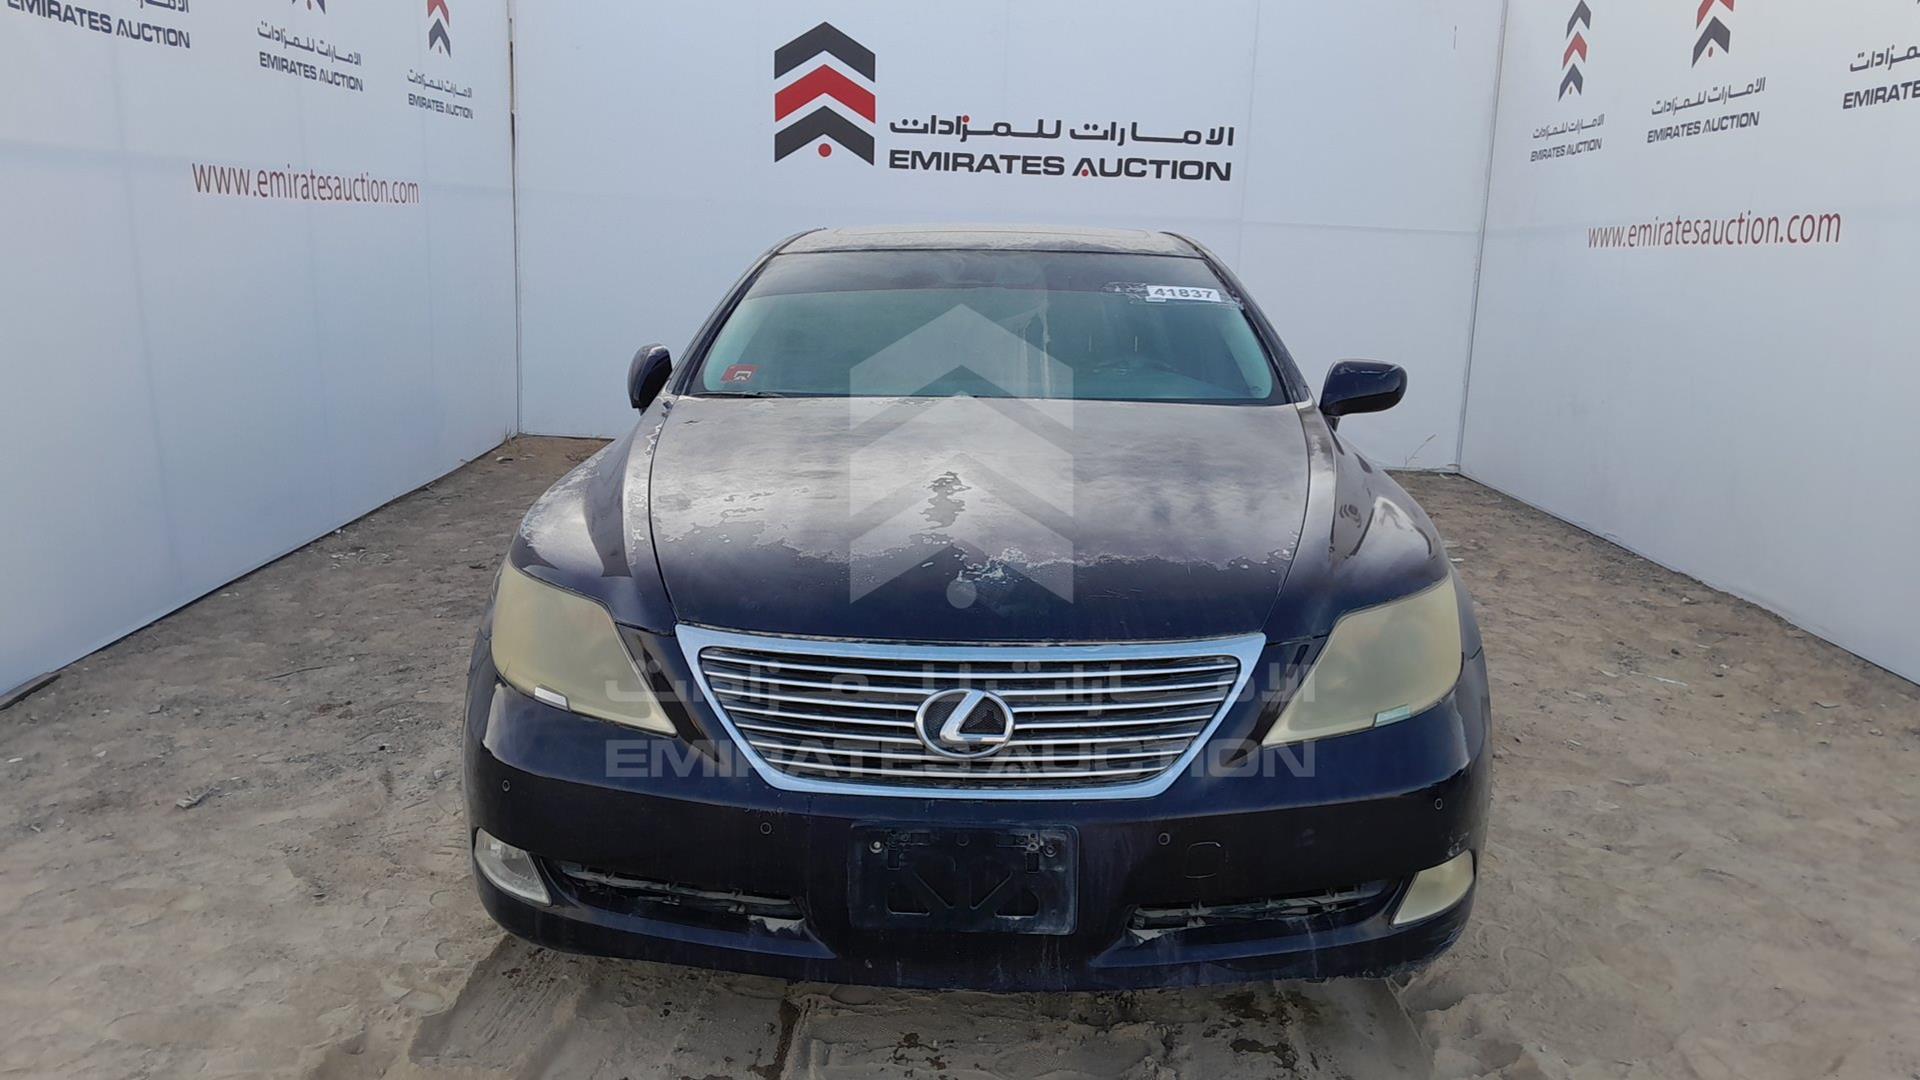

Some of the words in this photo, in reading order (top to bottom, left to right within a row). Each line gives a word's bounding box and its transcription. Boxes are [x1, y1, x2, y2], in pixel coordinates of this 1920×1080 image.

[116, 19, 190, 48] AUCTION
[259, 51, 317, 80] EMIRATES
[319, 68, 363, 92] AUCTION
[408, 93, 444, 113] EMIRATES
[1647, 121, 1701, 143] EMIRATES
[1703, 111, 1760, 133] AUCTION
[889, 149, 1065, 175] EMIRATES
[1072, 157, 1232, 181] AUCTION
[1530, 144, 1566, 162] EMIRATES
[1566, 137, 1603, 155] AUCTION
[192, 163, 419, 204] www.emiratesauction.com
[1588, 210, 1841, 248] www.emiratesauction.com
[1154, 288, 1213, 299] 41837
